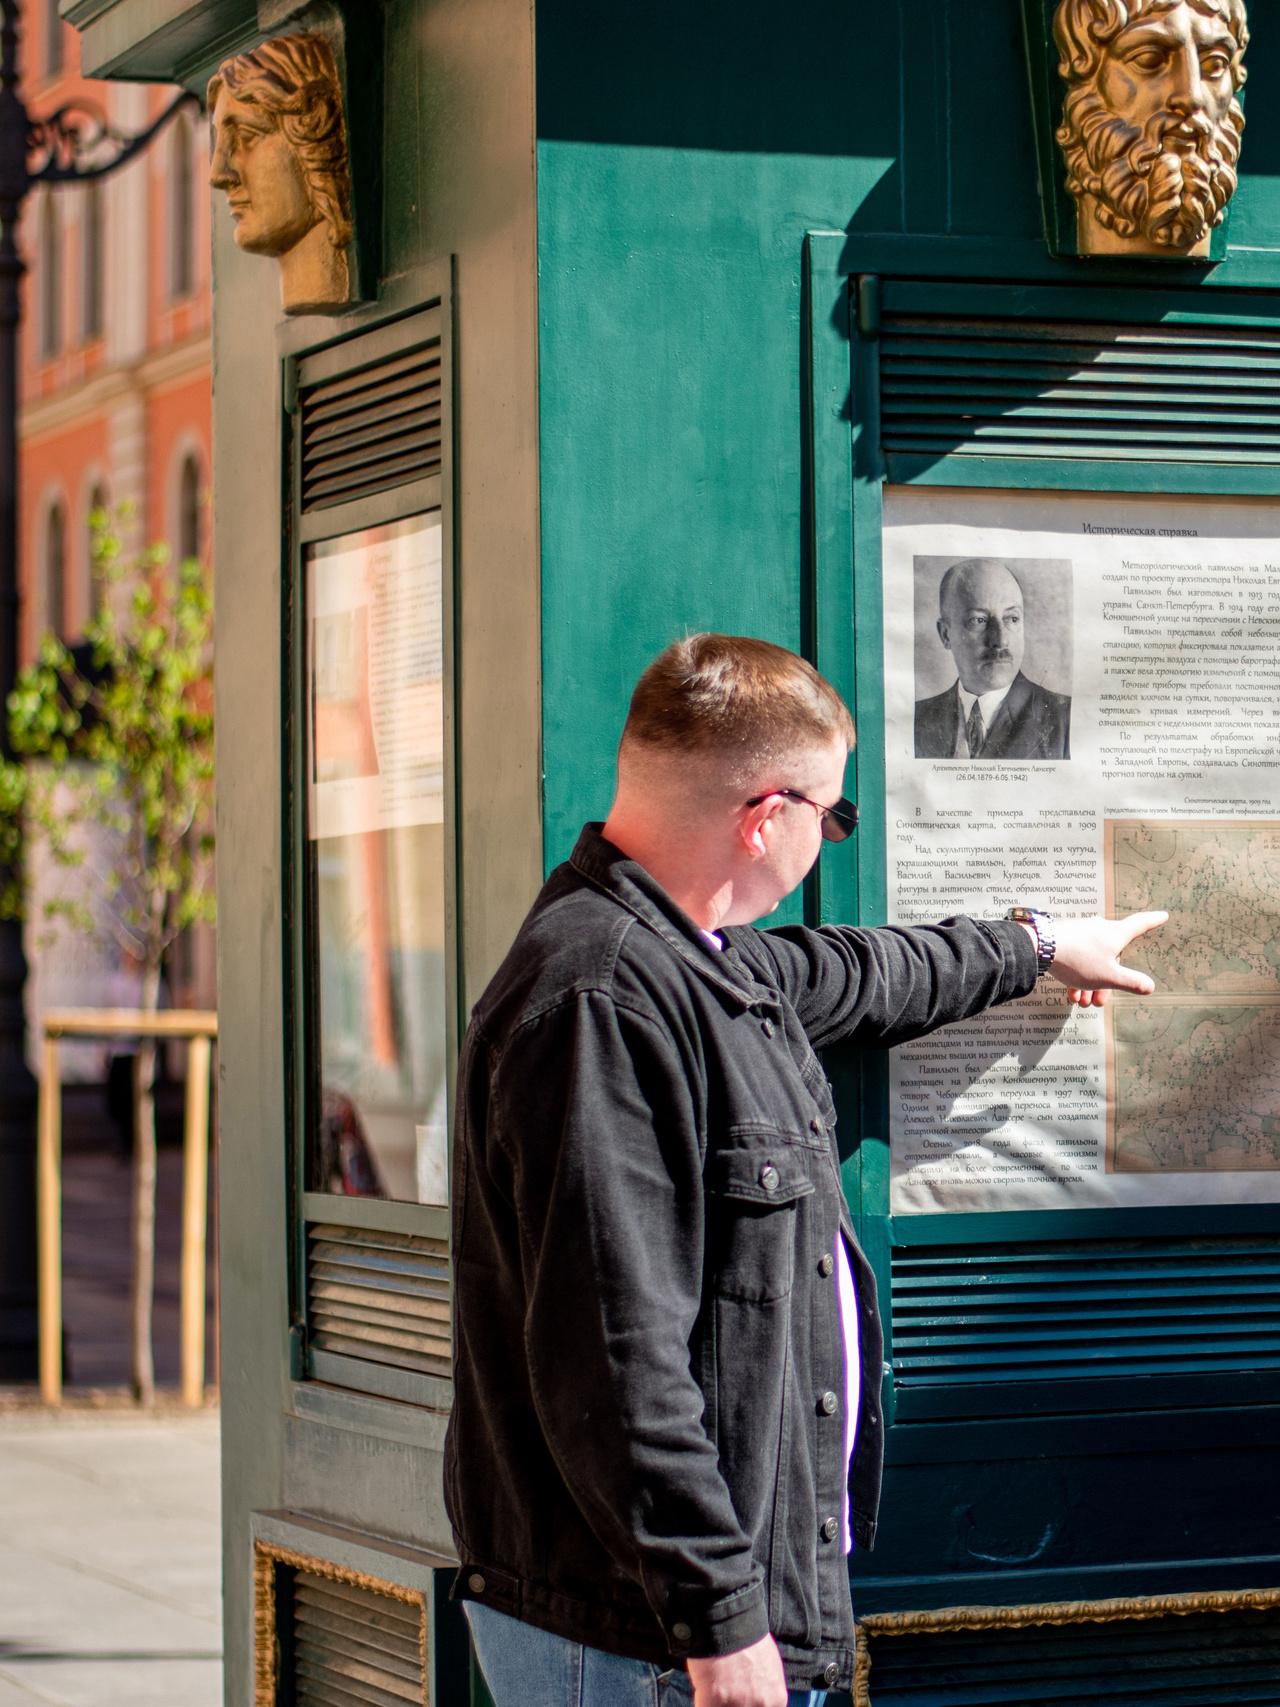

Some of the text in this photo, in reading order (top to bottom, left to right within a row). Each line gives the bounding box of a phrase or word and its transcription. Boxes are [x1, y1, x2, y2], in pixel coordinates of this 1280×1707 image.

[1082, 523, 1199, 539] Историческая справка
[1122, 560, 1202, 572] Метеорологический
[1142, 576, 1175, 585] проекту
[1177, 577, 1231, 586] архитектора
[1233, 575, 1266, 584] Николая
[1123, 586, 1161, 595] Павильон
[1167, 587, 1182, 596] был
[1249, 592, 1262, 600] 1913
[1102, 602, 1132, 611] управы
[1229, 605, 1243, 613] 1914
[1248, 606, 1264, 614] году
[1103, 612, 1155, 621] Конюшенной
[1157, 616, 1179, 624] улице
[1193, 617, 1240, 625] пересечении
[1248, 615, 1280, 624] Невским
[1124, 626, 1161, 635] Павильон
[1167, 630, 1215, 638] представлял
[1221, 628, 1242, 637] собой
[1144, 643, 1176, 651] которая
[1178, 642, 1227, 652] фиксировала
[1110, 656, 1165, 665] температуры
[1167, 657, 1196, 666] воздуха
[1155, 669, 1202, 678] хронологию
[1121, 680, 1149, 688] Точные
[1153, 680, 1186, 692] приборы
[1190, 681, 1231, 692] требовали
[1100, 694, 1138, 702] заводился
[1099, 708, 1141, 717] чертилась
[1150, 709, 1177, 717] кривая
[1241, 708, 1263, 718] Через
[1144, 735, 1198, 743] результатам
[1211, 732, 1254, 743] обработки
[1100, 746, 1156, 758] поступающей
[1170, 746, 1212, 757] телеграфу
[1225, 746, 1274, 757] Европейской
[1115, 757, 1153, 767] Западной
[1193, 760, 1238, 768] создавалась
[1102, 772, 1135, 780] прогноз
[987, 811, 1024, 819] примера
[1039, 810, 1096, 819] представлена
[896, 820, 960, 829] Синоптическая
[968, 823, 996, 831] карта,
[1079, 822, 1096, 830] 1909
[897, 835, 915, 844] году.
[915, 845, 931, 854] Над
[936, 847, 1003, 856] скульптурными
[1067, 847, 1096, 856] чугуна,
[896, 861, 958, 870] украшающими
[1013, 858, 1047, 869] работал
[1054, 861, 1096, 869] скульптор
[897, 870, 1096, 882] Василий Васильевич Кузнецов. Золоченые
[897, 884, 929, 896] фигуры
[1016, 884, 1072, 895] обрамляющие
[897, 896, 1097, 908] символизируют Время. Изначально
[983, 910, 1005, 919] были
[1046, 998, 1063, 1006] С.М.
[969, 1012, 1024, 1023] заброшенном
[944, 1025, 1024, 1038] временем барограф
[906, 1040, 961, 1049] самописцами
[919, 1063, 980, 1074] Павильон был
[900, 1074, 1088, 1089] возвращен Малую Конюшенную улицу
[900, 1090, 1099, 1102] створе Чебоксарского переулка 1997 году.
[902, 1103, 929, 1113] Одним
[903, 1115, 935, 1123] Алексей
[1058, 1114, 1099, 1122] создателя
[904, 1127, 949, 1137] старинной
[923, 1140, 953, 1149] Осенью
[964, 1139, 981, 1147] 2018
[992, 1141, 1011, 1150] года
[904, 1151, 982, 1163] отремонтировали,
[992, 1164, 1046, 1175] современные
[1057, 1175, 1084, 1186] время.
